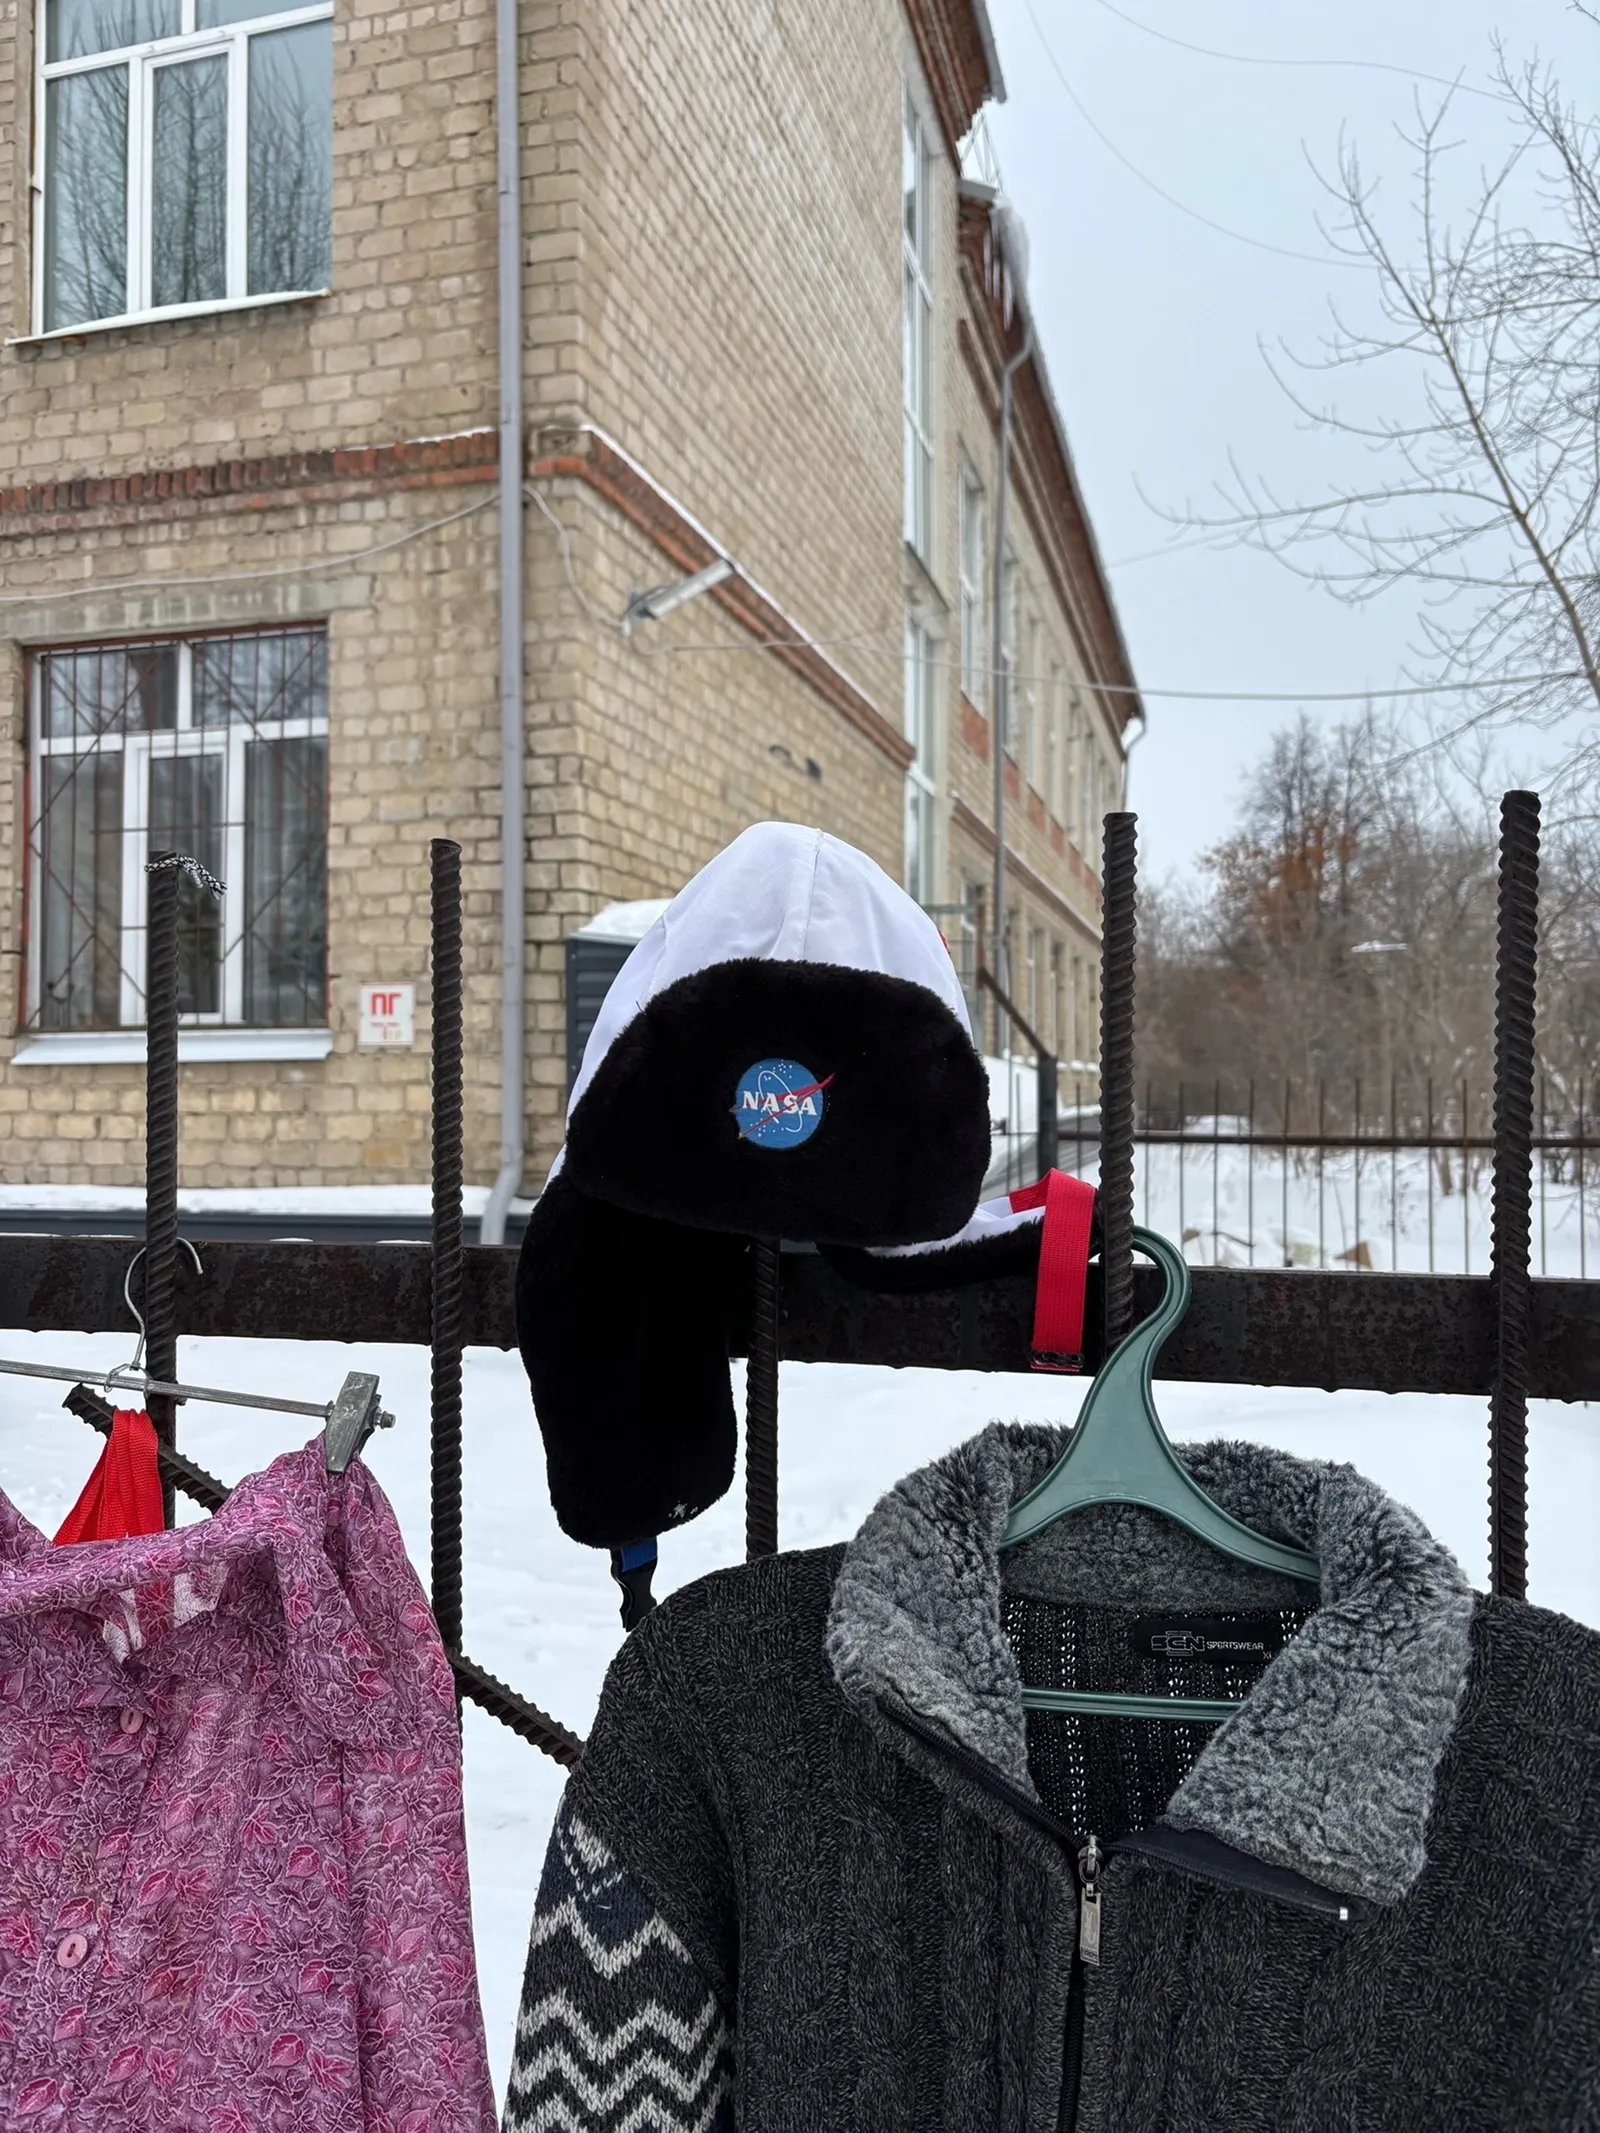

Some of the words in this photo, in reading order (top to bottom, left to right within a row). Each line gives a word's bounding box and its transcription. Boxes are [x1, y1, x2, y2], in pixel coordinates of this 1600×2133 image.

[371, 992, 402, 1015] ПГ
[742, 1090, 818, 1116] NASA
[1206, 1640, 1264, 1651] SPORTSWEAR
